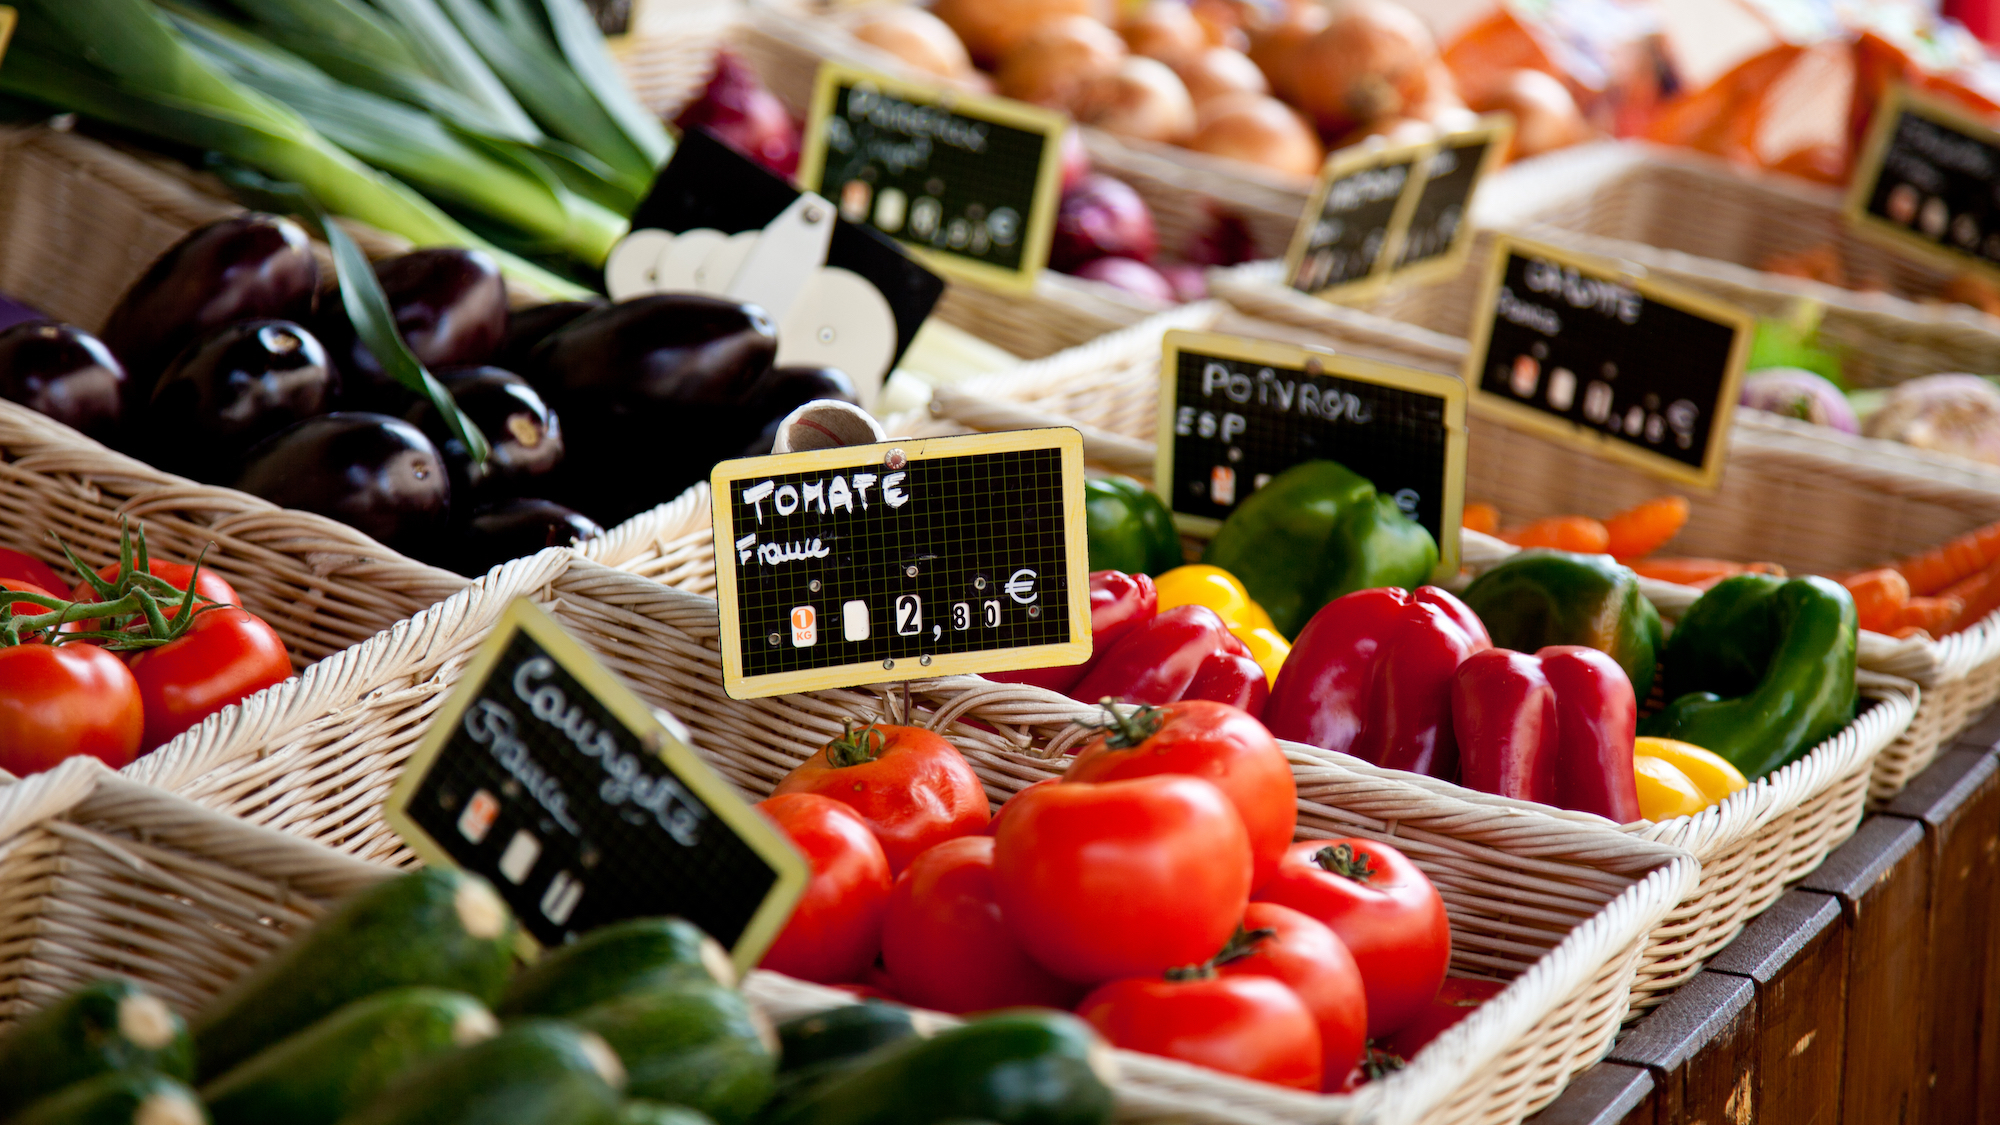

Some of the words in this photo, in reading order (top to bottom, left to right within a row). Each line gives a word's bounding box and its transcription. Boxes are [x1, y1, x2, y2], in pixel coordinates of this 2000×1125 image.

[1177, 406, 1246, 441] ESP
[743, 472, 909, 525] TOMATE
[1004, 568, 1038, 604] €
[796, 630, 812, 641] KG
